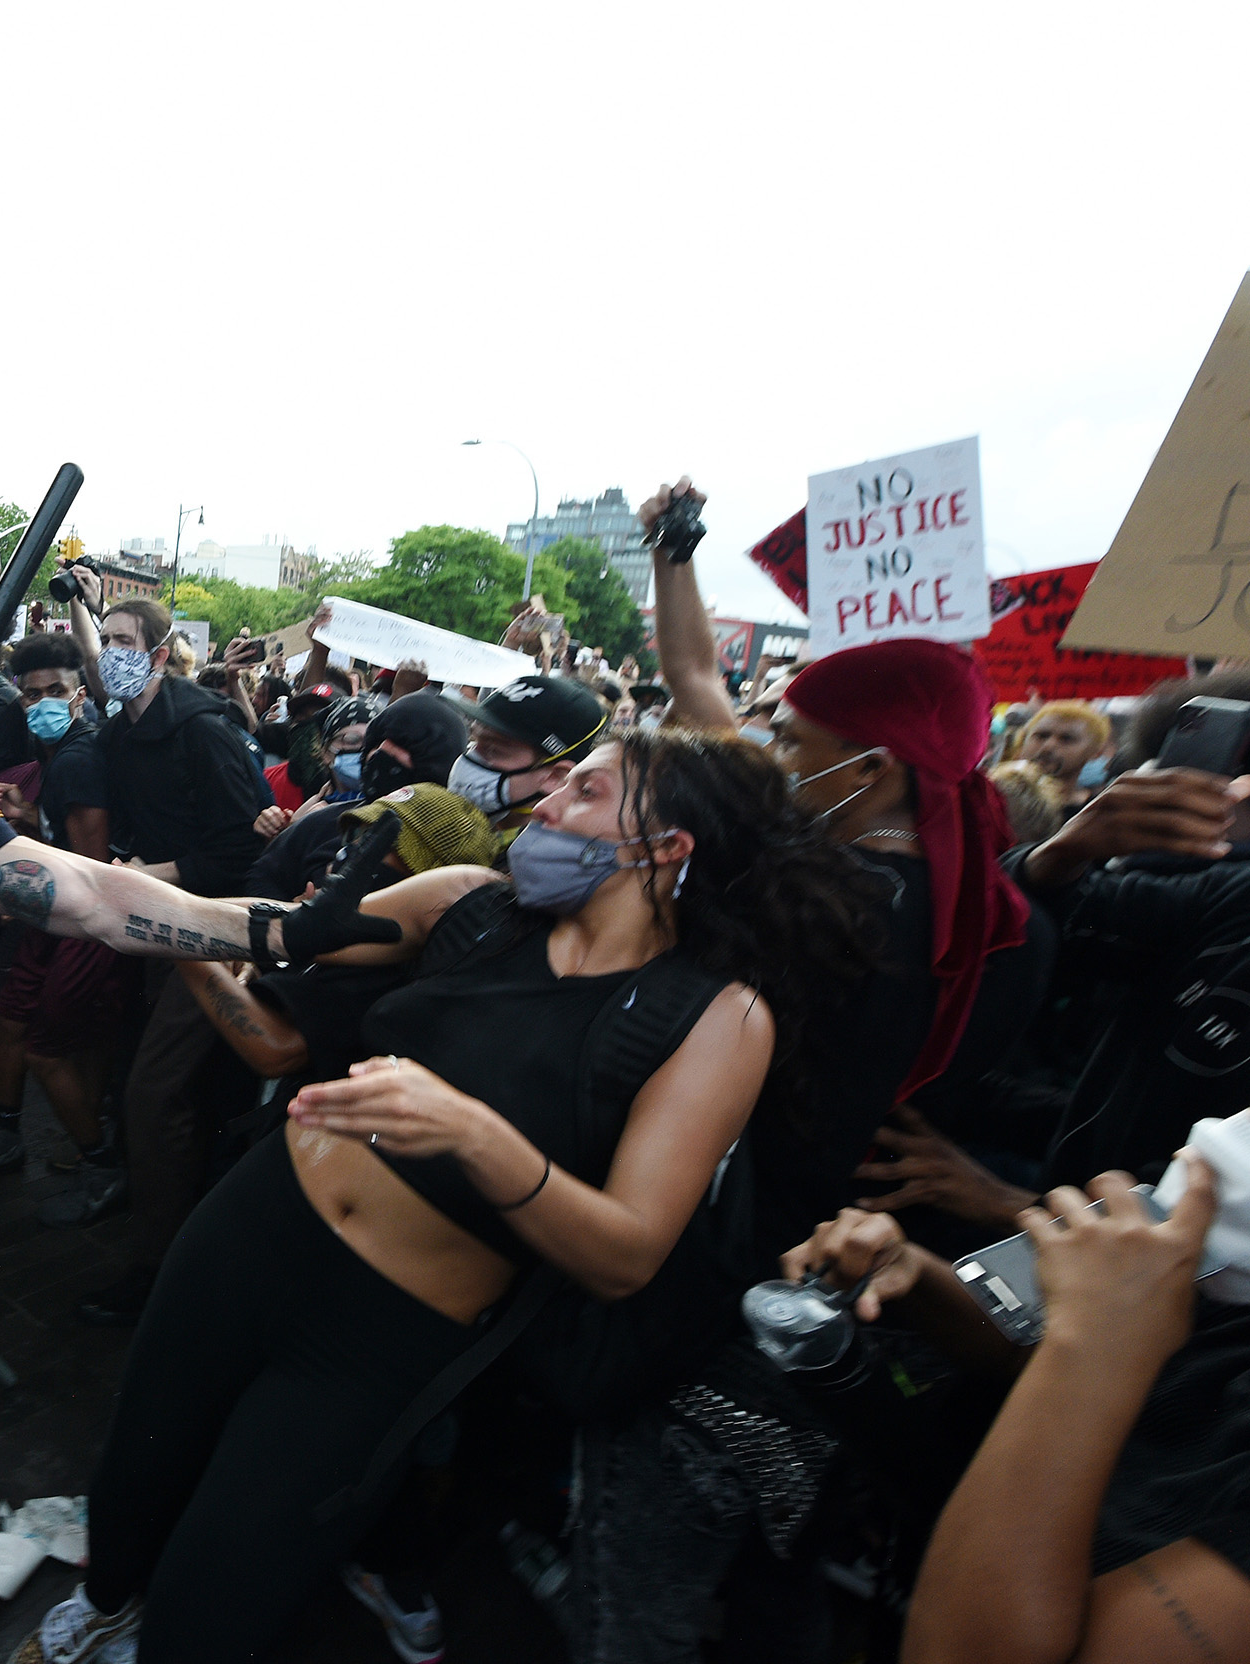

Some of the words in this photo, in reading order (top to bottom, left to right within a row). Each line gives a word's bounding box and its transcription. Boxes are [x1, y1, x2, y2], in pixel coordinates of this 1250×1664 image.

[856, 467, 914, 511] NO
[821, 487, 971, 554] JUSTICE
[865, 545, 912, 583] NO
[836, 572, 965, 636] PEACE
